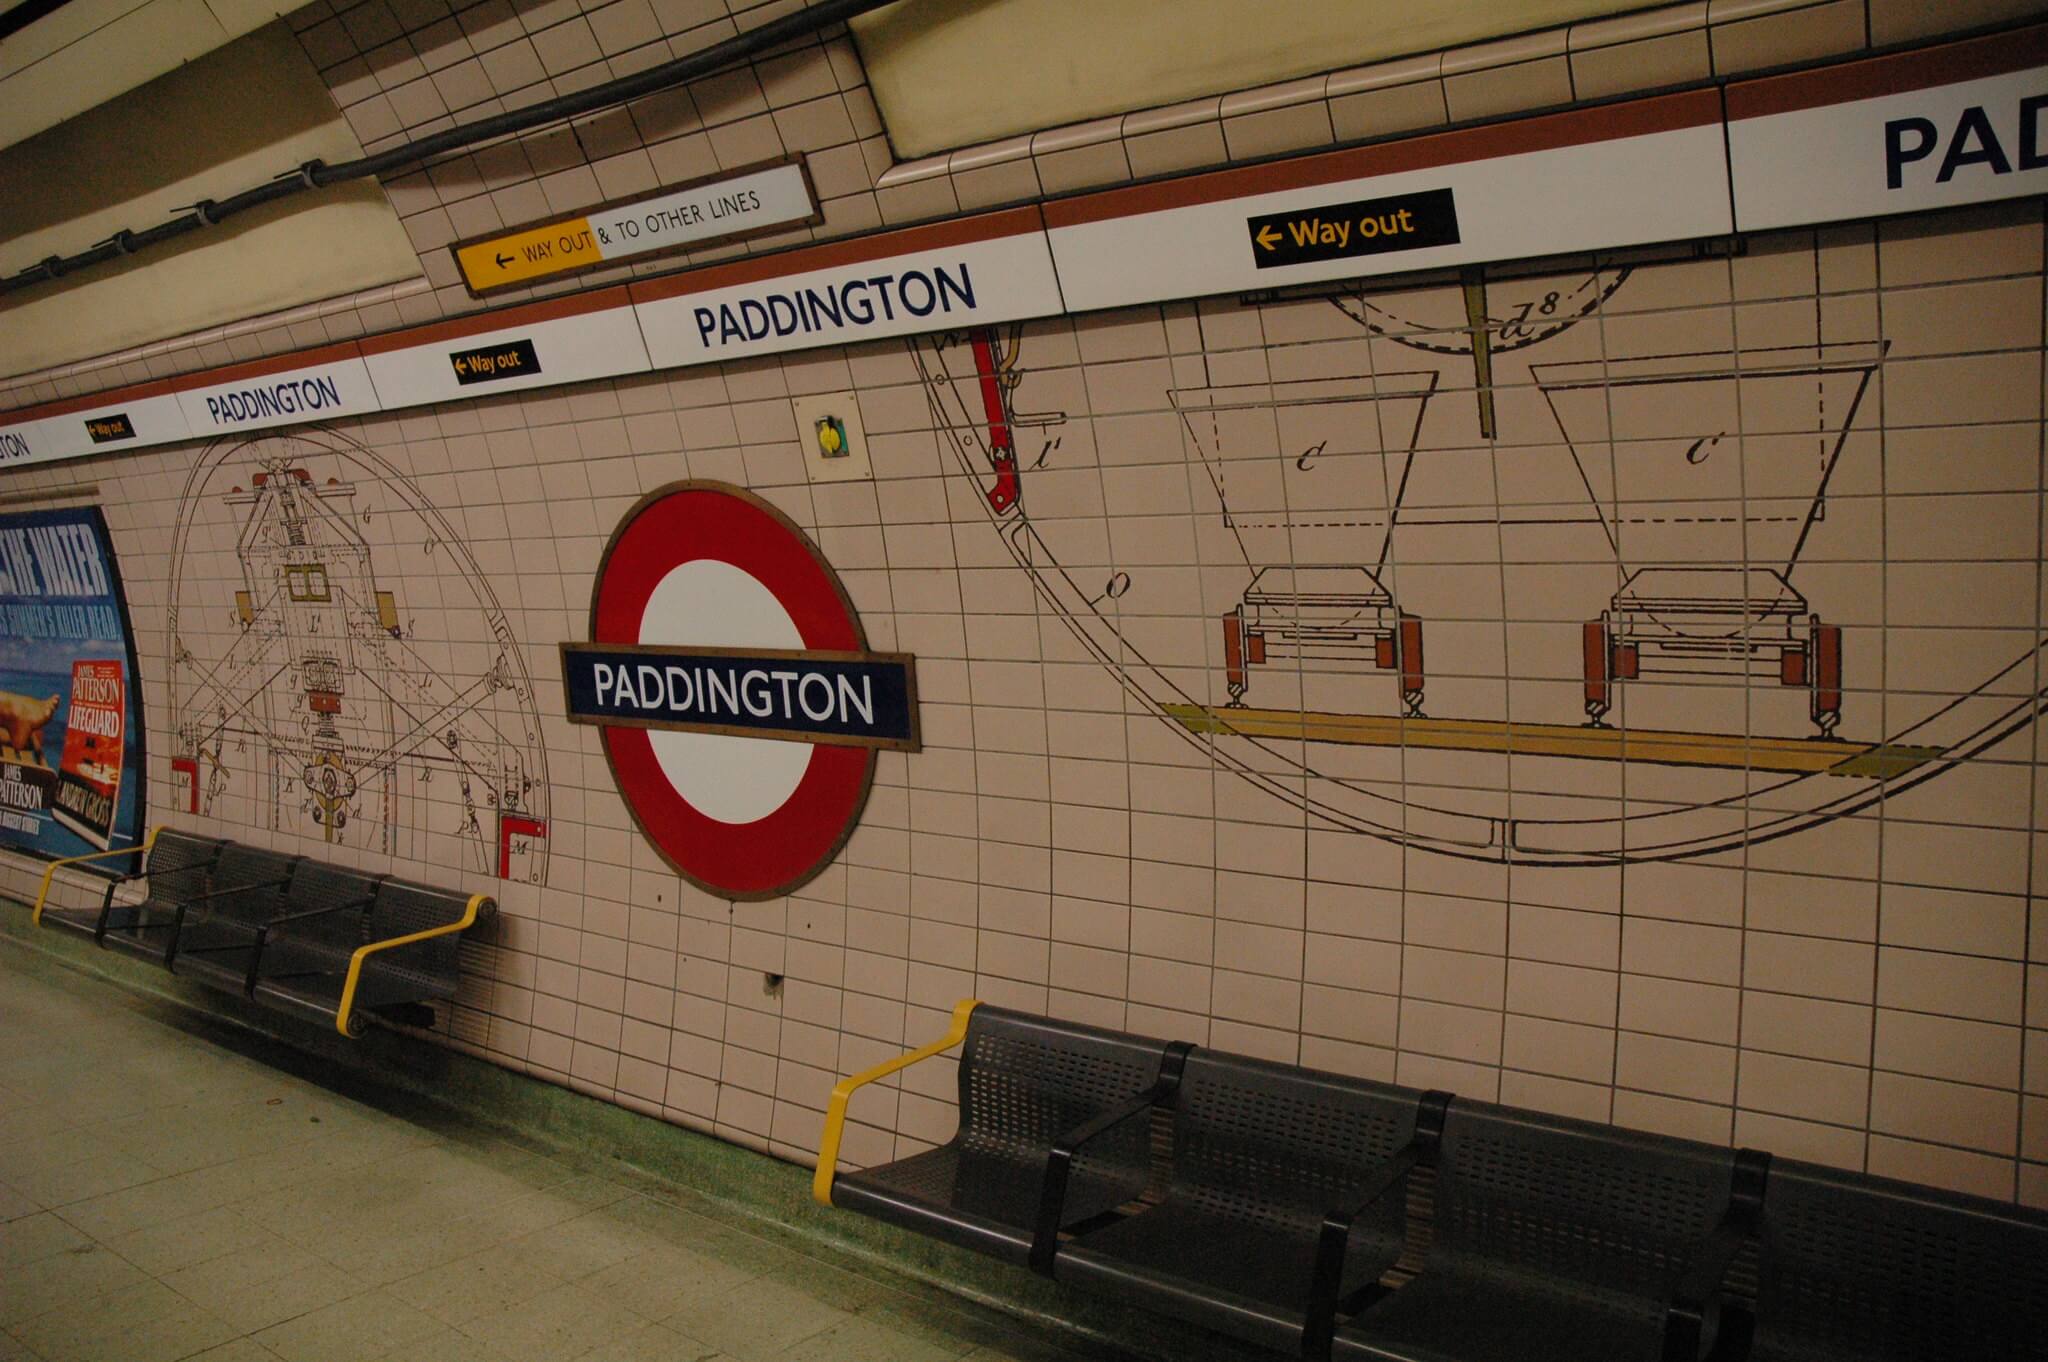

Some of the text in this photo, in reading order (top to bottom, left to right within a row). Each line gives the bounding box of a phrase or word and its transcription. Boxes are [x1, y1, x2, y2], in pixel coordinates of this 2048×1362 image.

[521, 190, 761, 264] WAY OUT & TO OTHER LINES
[1287, 208, 1415, 249] Way out
[694, 263, 977, 348] PADDINGTON
[466, 350, 522, 375] Way out
[206, 376, 341, 424] PADDINGTON
[0, 431, 31, 459] TON
[26, 523, 110, 596] WATER
[72, 676, 121, 705] PATTERSON
[77, 665, 95, 679] JAMES
[593, 663, 875, 725] PADDINGTON
[68, 704, 120, 738] LIFEGUARD
[3, 763, 22, 782] JAMES
